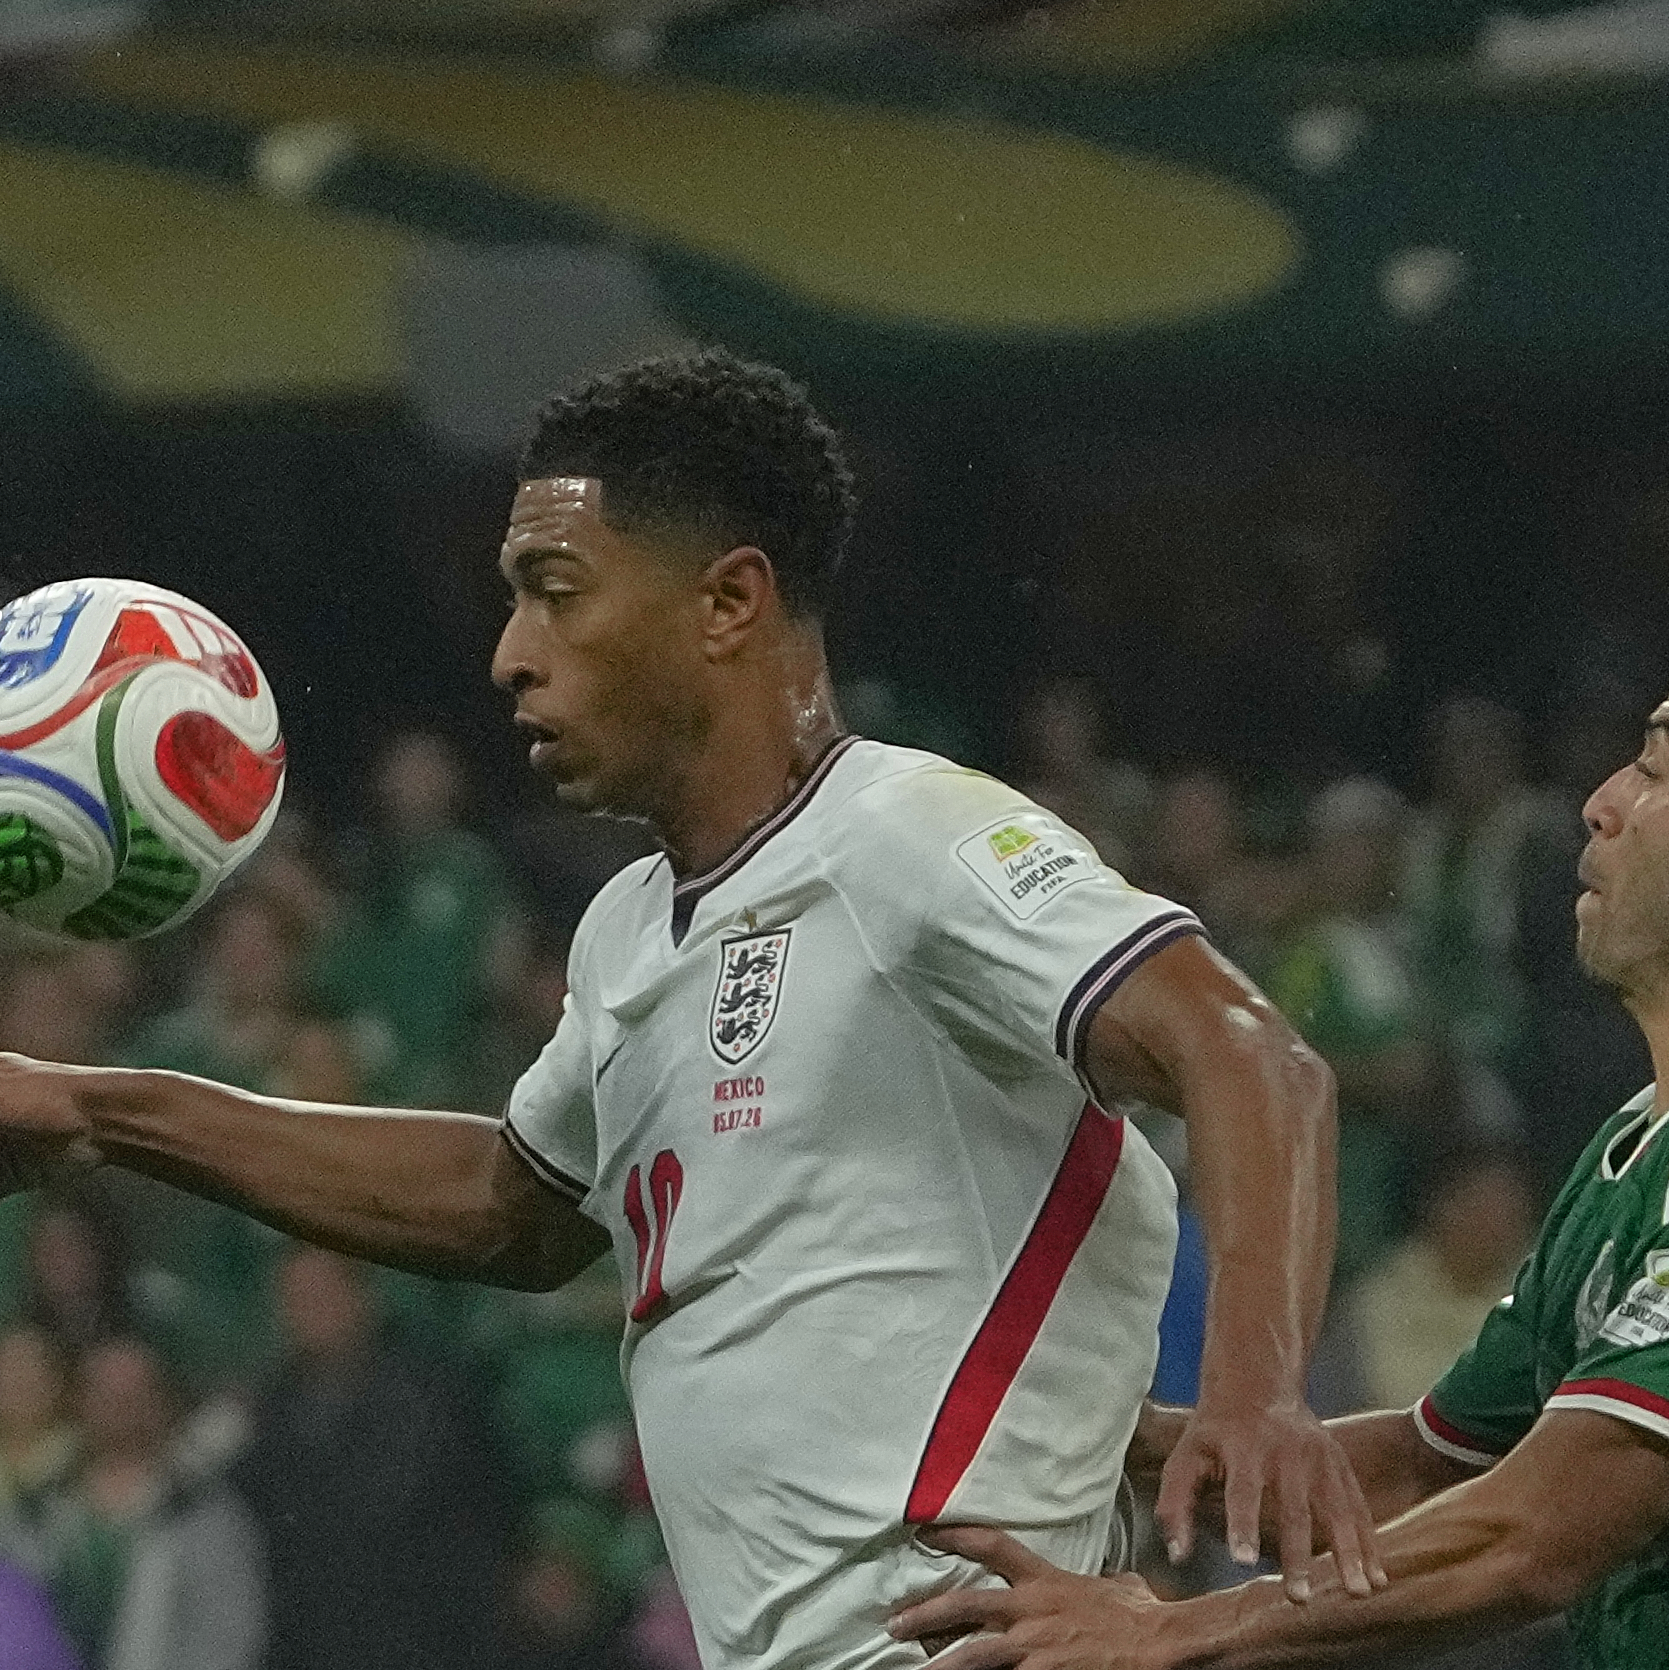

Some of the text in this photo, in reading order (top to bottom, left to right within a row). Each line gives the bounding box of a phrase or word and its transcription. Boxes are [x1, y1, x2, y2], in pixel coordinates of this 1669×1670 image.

[1010, 854, 1080, 900] EDUCATION
[1041, 876, 1068, 894] FIFA
[714, 1076, 765, 1101] MEXICO
